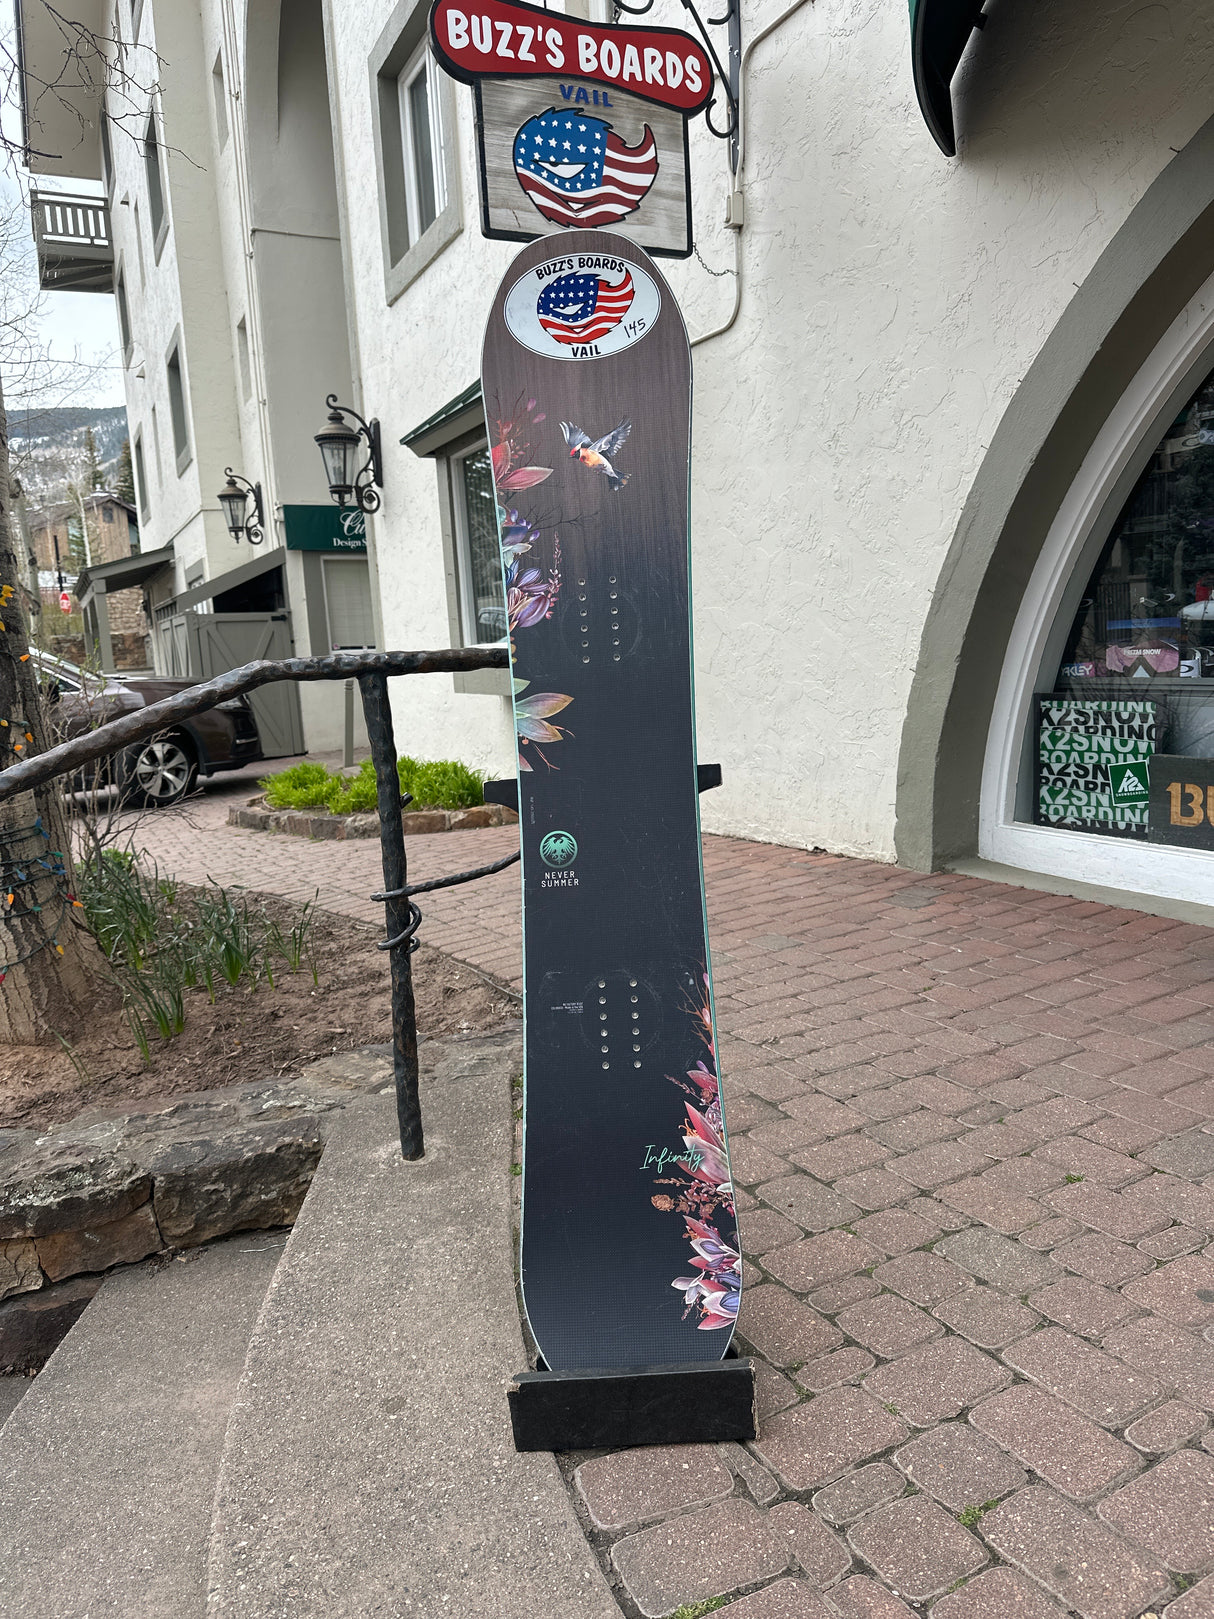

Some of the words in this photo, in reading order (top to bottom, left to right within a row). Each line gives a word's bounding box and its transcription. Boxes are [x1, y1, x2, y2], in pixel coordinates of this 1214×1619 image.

[446, 9, 565, 69] BUZZ'S
[577, 34, 701, 93] BOARDS
[559, 84, 613, 107] VAIL
[535, 259, 574, 280] BUZZ'S
[578, 257, 625, 273] BOARDS
[623, 318, 646, 338] 145
[571, 344, 602, 358] VAIL
[333, 538, 361, 549] Design
[1142, 648, 1162, 656] SNOW
[1061, 663, 1093, 677] AKLEY
[544, 871, 575, 879] NEVER
[541, 879, 579, 888] SUMMER
[639, 1143, 706, 1174] Infinity
